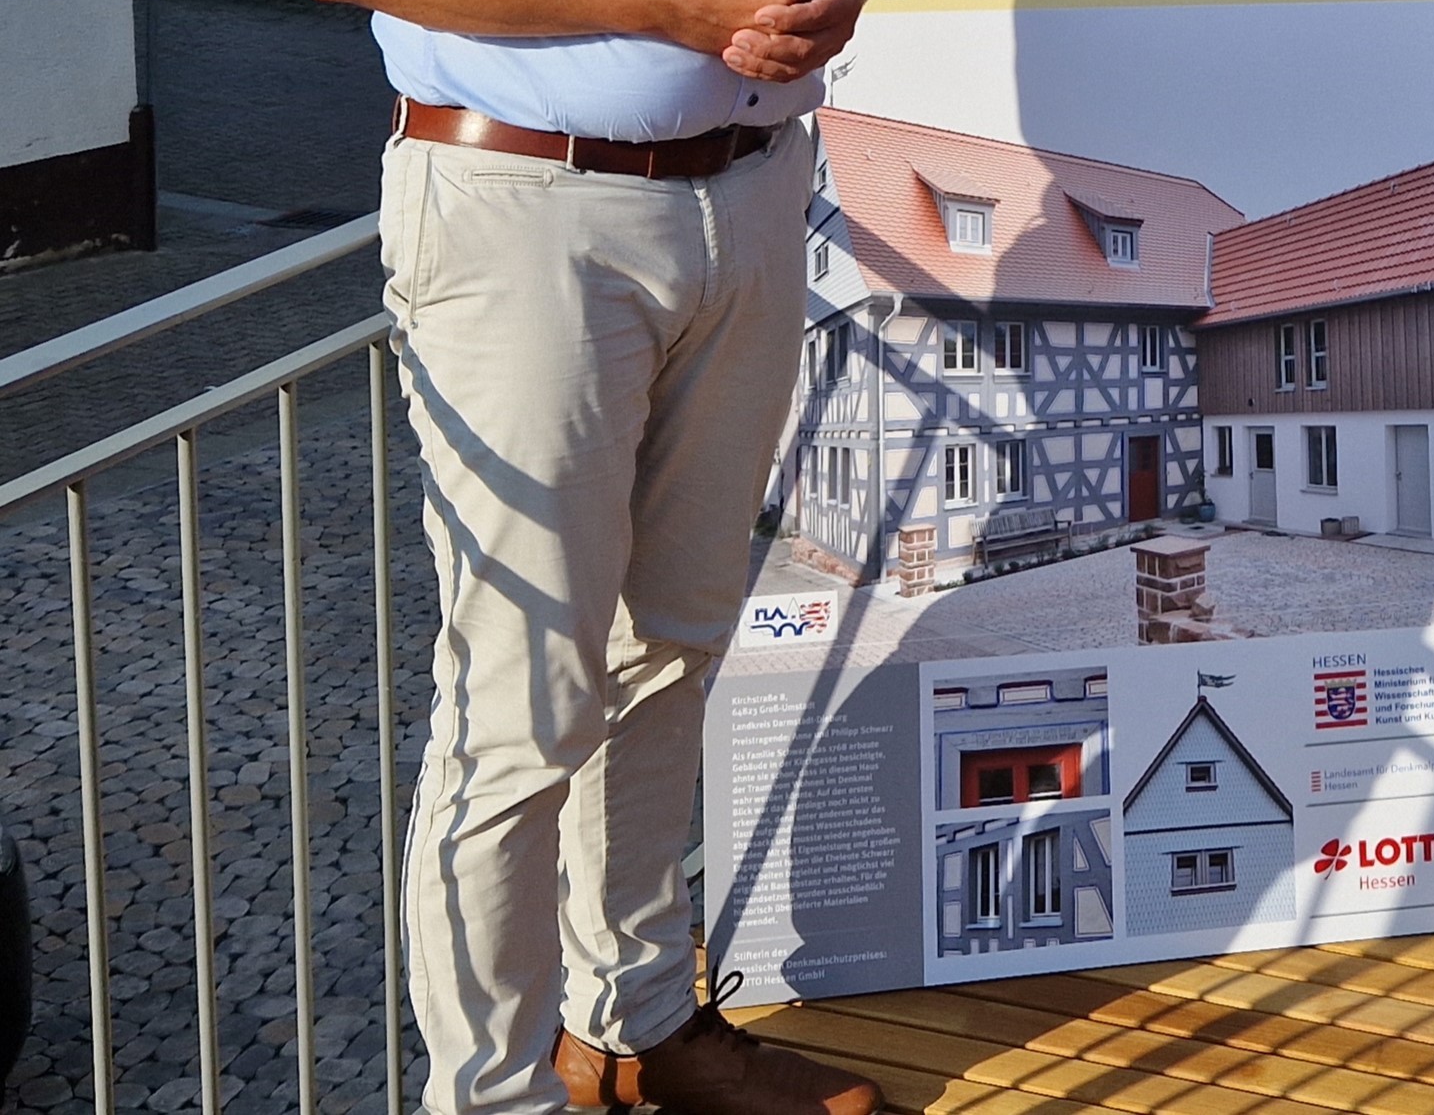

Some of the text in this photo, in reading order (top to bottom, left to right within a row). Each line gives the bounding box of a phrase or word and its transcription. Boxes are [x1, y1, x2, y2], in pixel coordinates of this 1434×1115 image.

[1312, 654, 1367, 668] HESSEN
[1373, 665, 1425, 676] Hessisches
[1374, 676, 1428, 688] Ministerium
[732, 694, 778, 705] Kirchstraße
[1374, 688, 1434, 700] Wissenschaft
[1375, 702, 1393, 712] und
[1375, 714, 1402, 724] Kunst
[1404, 713, 1422, 722] und
[732, 720, 771, 731] Landkreis
[831, 728, 858, 737] Philipp
[860, 725, 894, 735] Schwarz
[732, 752, 745, 761] Als
[747, 750, 775, 760] Familie
[732, 762, 768, 772] Gebäude
[769, 761, 777, 769] in
[1324, 766, 1375, 779] Landesamt
[1376, 764, 1389, 775] für
[732, 774, 755, 783] ahnte
[757, 772, 769, 781] sie
[819, 767, 827, 775] in
[828, 765, 858, 774] diesem
[859, 763, 879, 771] Haus
[732, 786, 746, 794] der
[748, 784, 772, 793] Traum
[826, 777, 837, 785] im
[838, 773, 873, 784] Denkmal
[1324, 780, 1358, 791] Hessen
[732, 796, 752, 805] wahr
[816, 788, 830, 797] Auf
[831, 787, 847, 796] den
[848, 784, 874, 794] ersten
[732, 807, 752, 816] Blick
[828, 797, 847, 807] noch
[849, 795, 869, 805] nicht
[871, 806, 886, 814] das
[767, 849, 780, 858] Mit
[853, 839, 868, 849] und
[811, 855, 823, 864] die
[861, 849, 894, 859] Schwarz
[823, 864, 838, 873] und
[880, 858, 895, 868] viel
[874, 870, 887, 879] die
[1359, 874, 1415, 890] Hessen
[734, 948, 788, 961] Stifterin des
[798, 970, 825, 981] GmbH
